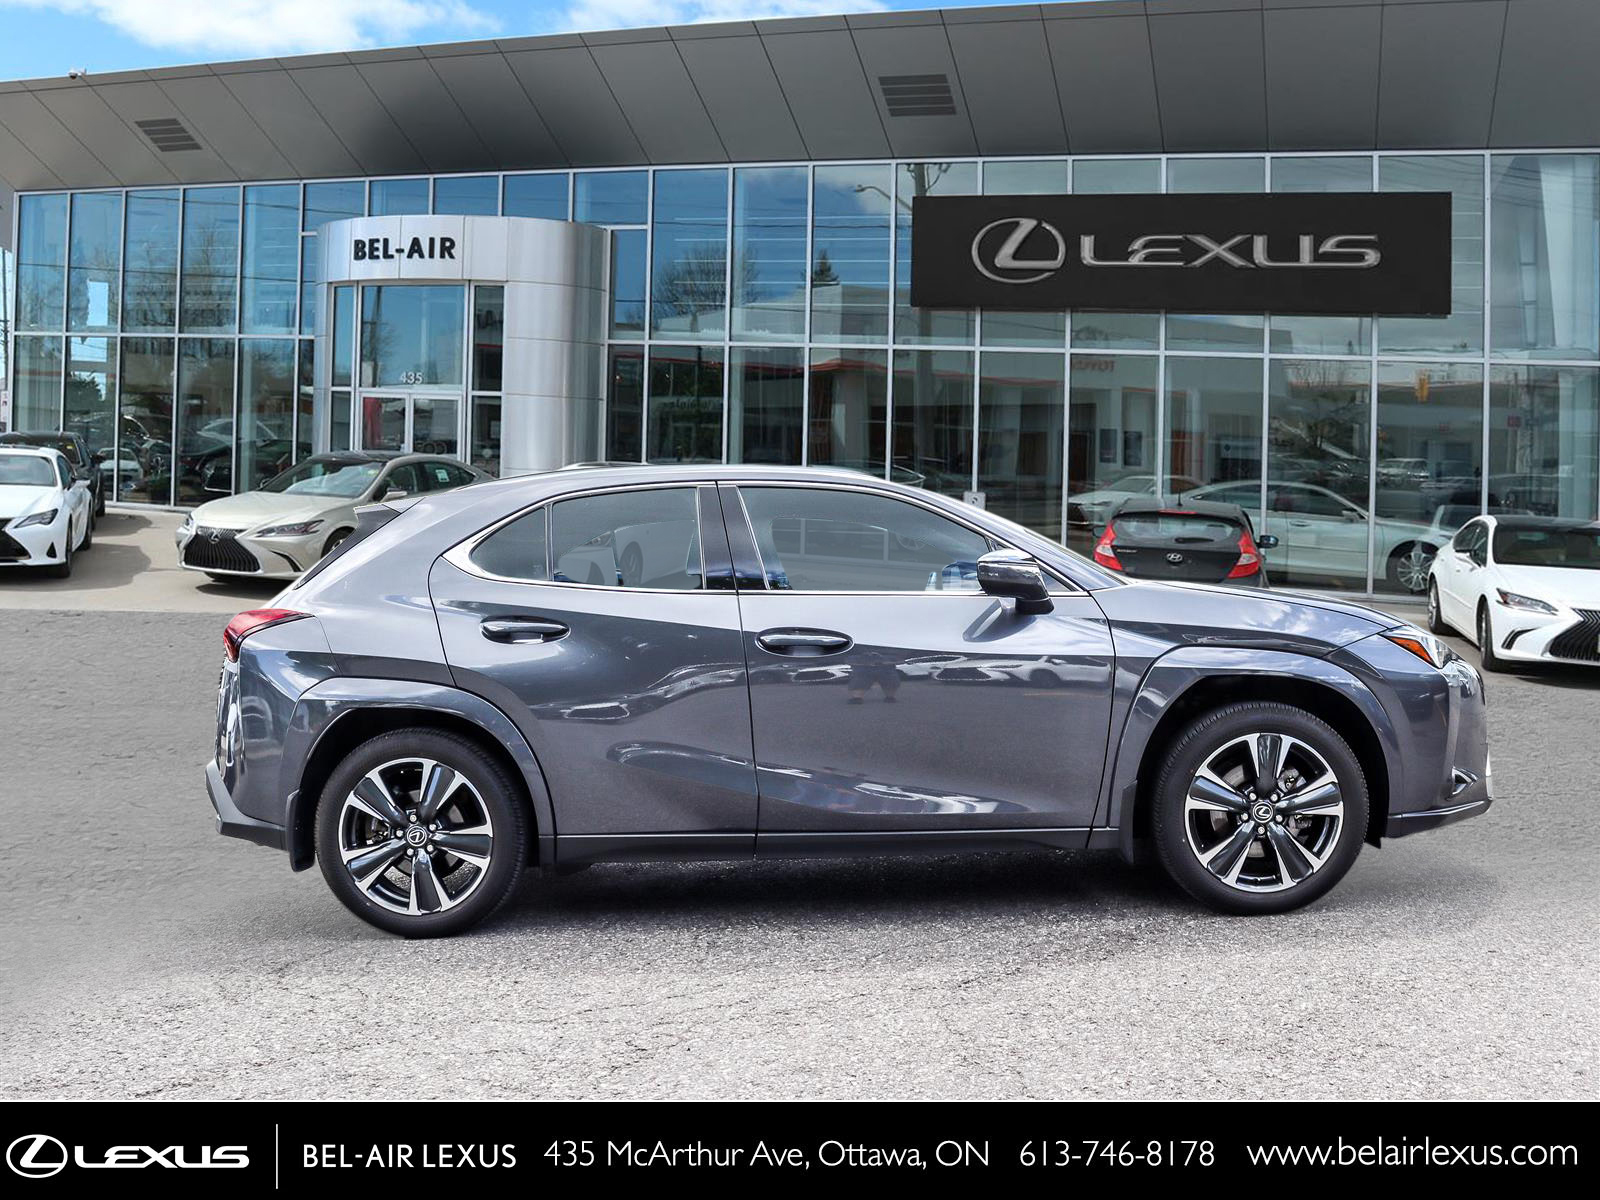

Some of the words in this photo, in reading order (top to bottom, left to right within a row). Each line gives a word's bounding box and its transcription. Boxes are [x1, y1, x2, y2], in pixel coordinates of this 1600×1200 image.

[353, 236, 457, 261] BEL-AIR
[1079, 233, 1382, 269] LEXUS
[400, 371, 424, 385] 435
